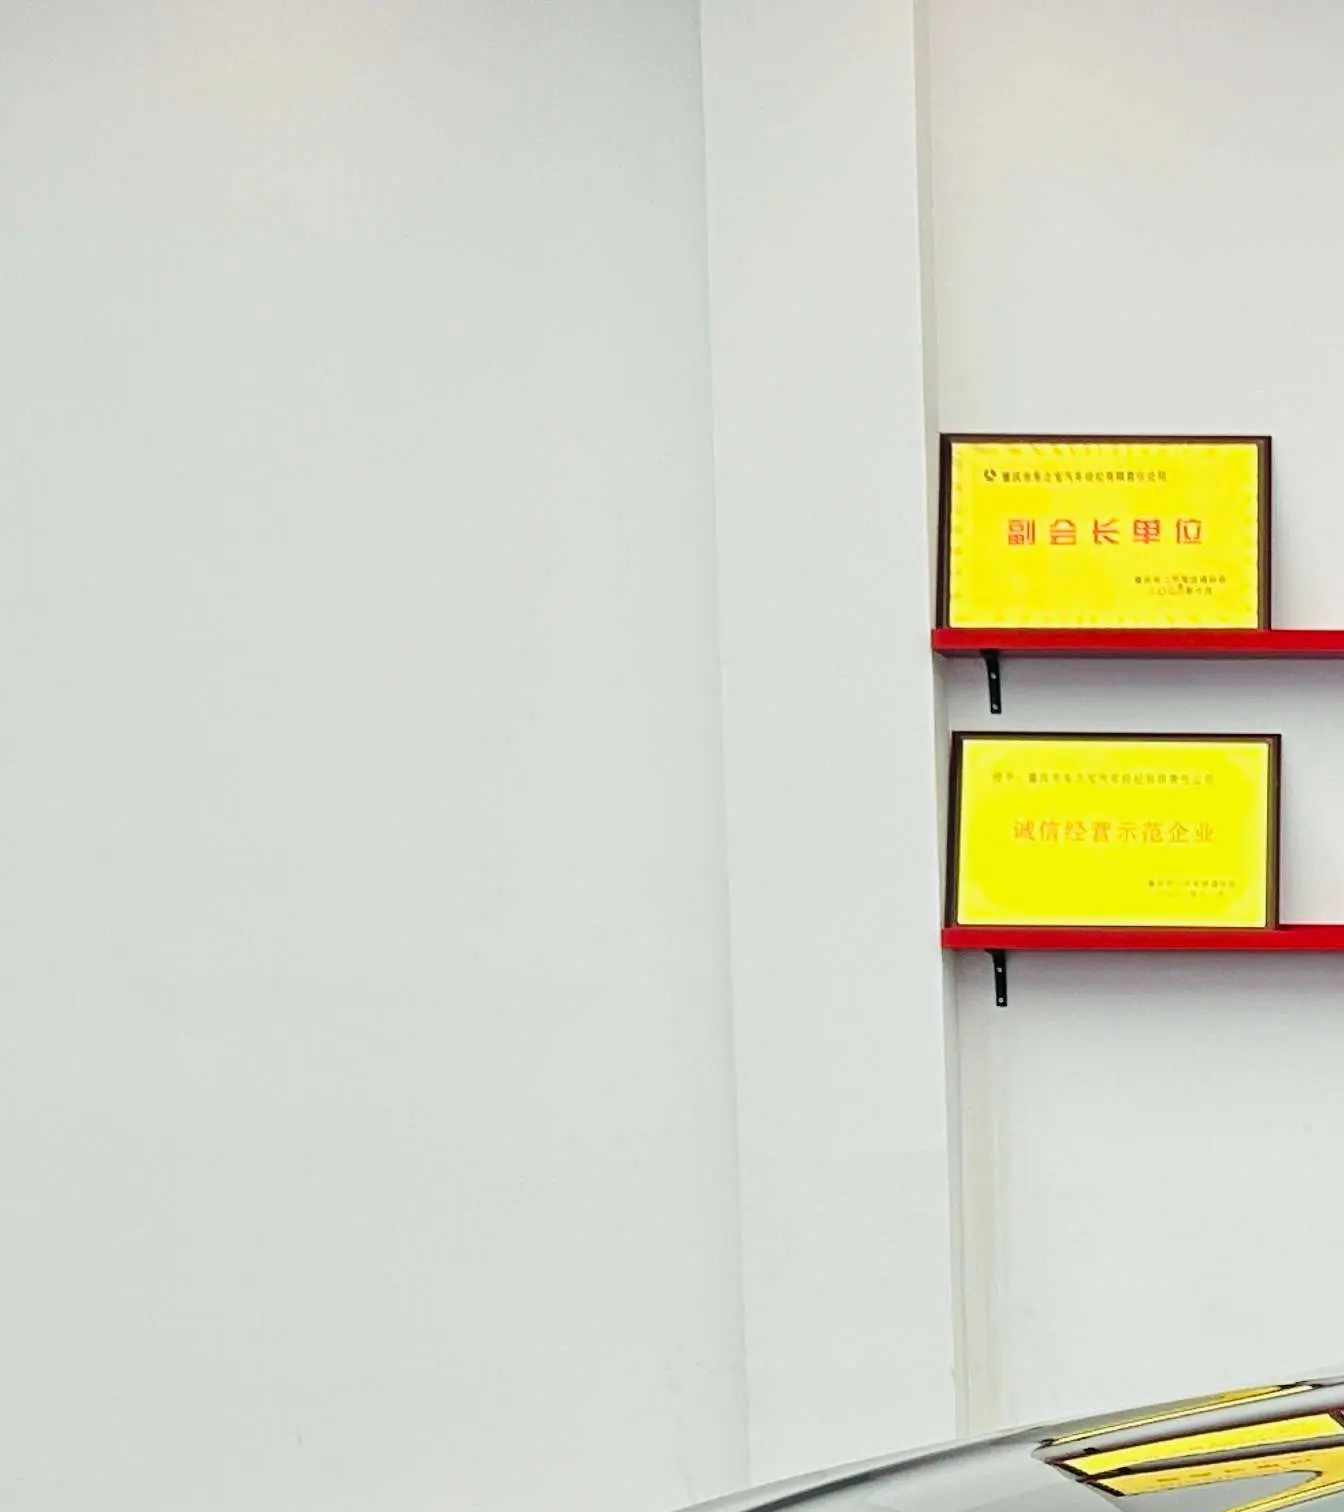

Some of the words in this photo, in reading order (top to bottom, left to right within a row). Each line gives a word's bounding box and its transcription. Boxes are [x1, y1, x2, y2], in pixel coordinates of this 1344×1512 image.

[1008, 519, 1202, 545] 副会长单位
[1013, 819, 1215, 844] 诚信经营示范企业
